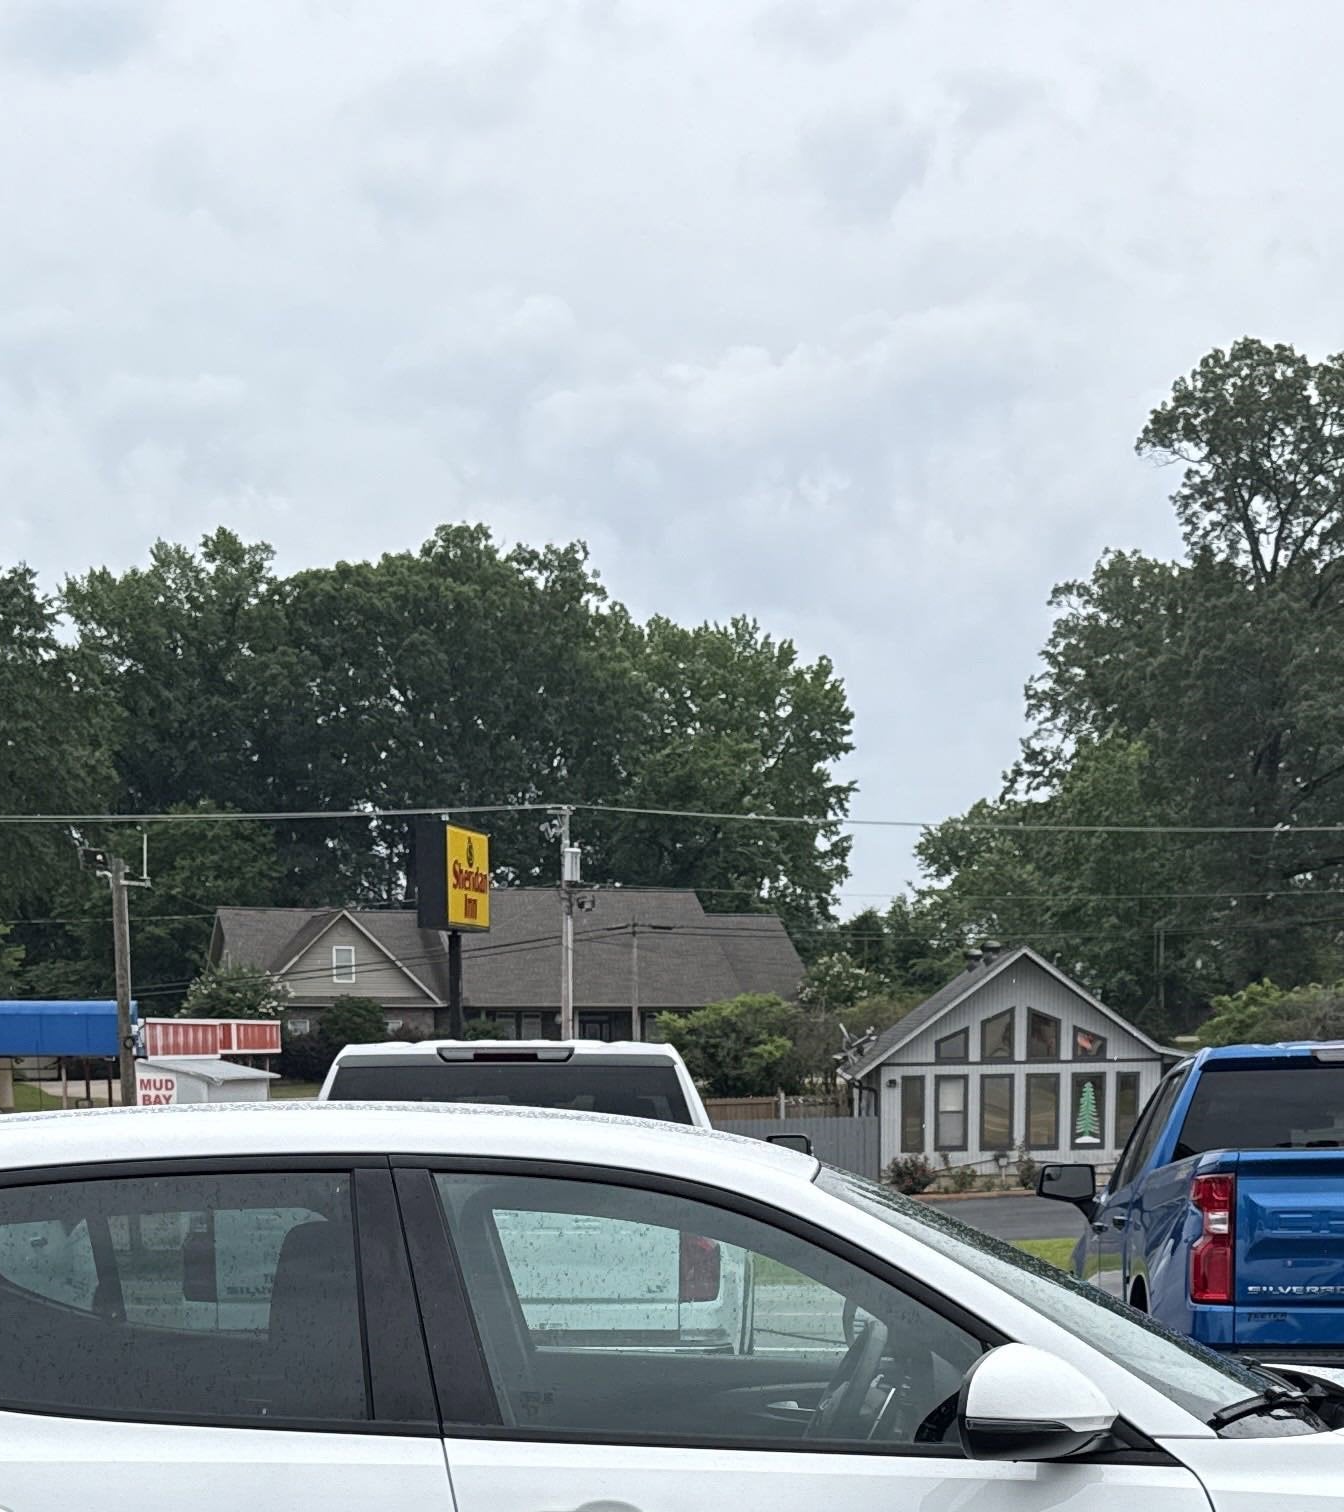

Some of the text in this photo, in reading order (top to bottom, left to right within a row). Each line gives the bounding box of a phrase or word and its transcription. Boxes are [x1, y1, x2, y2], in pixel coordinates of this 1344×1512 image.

[452, 859, 488, 894] Sheridan
[464, 893, 478, 920] Inn
[139, 1079, 175, 1091] MUD
[142, 1094, 173, 1106] BAY
